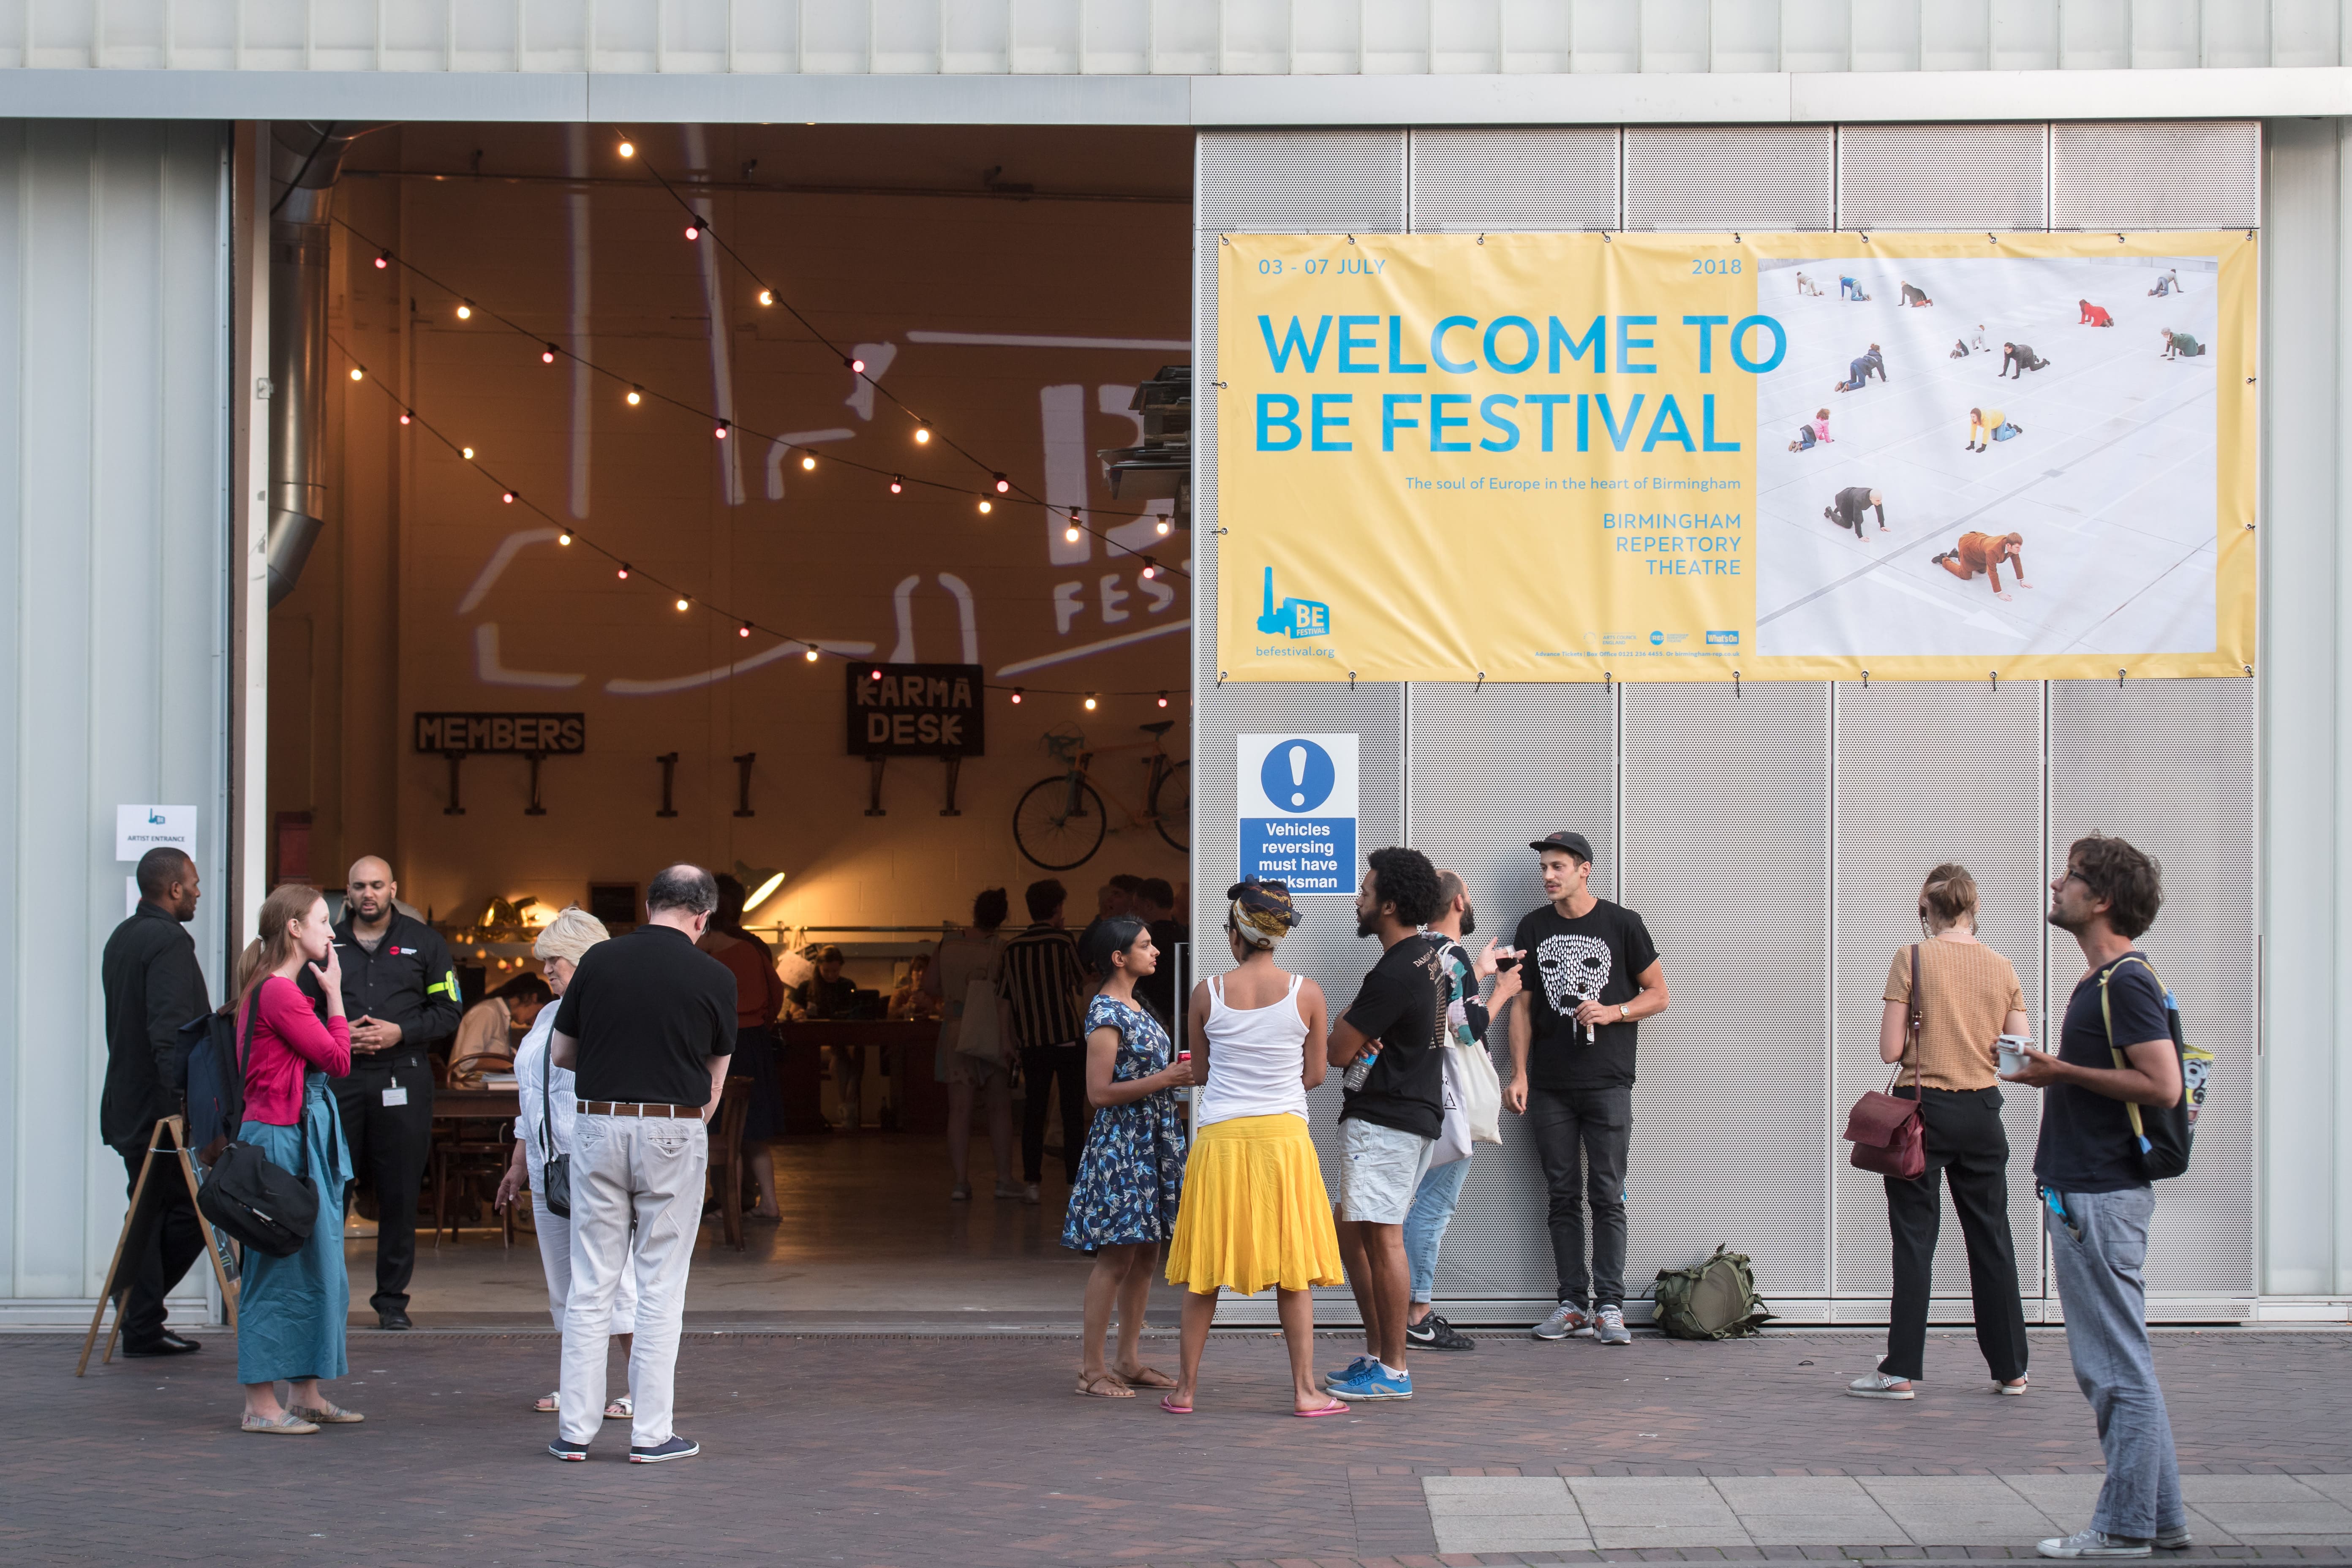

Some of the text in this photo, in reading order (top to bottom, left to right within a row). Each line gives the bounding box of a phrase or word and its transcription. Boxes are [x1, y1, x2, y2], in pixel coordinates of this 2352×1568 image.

[1258, 259, 1283, 275] 03
[1305, 259, 1329, 275] 07
[1337, 259, 1386, 275] JULY
[1692, 259, 1742, 275] 2018
[1257, 315, 1787, 375] WELCOME TO
[1256, 393, 1741, 453] BE FESTIVAL
[1405, 477, 1741, 493] The soul of Europe in the heart of Birmingham
[1603, 513, 1741, 529] BIRMINGHAM
[1617, 536, 1742, 553] REPERTORY
[1645, 560, 1741, 575] THEATRE
[1054, 558, 1190, 634] FES
[1296, 604, 1324, 628] BE
[1296, 628, 1326, 636] FESTIVAL
[1707, 634, 1737, 642] What's On
[1256, 646, 1335, 659] befestival.org
[856, 674, 972, 709] KARMA
[419, 716, 584, 751] MEMBERS
[867, 714, 962, 746] DESK
[1266, 823, 1330, 836] Vehicles
[1262, 841, 1334, 857] reversing
[1259, 858, 1338, 871] must have
